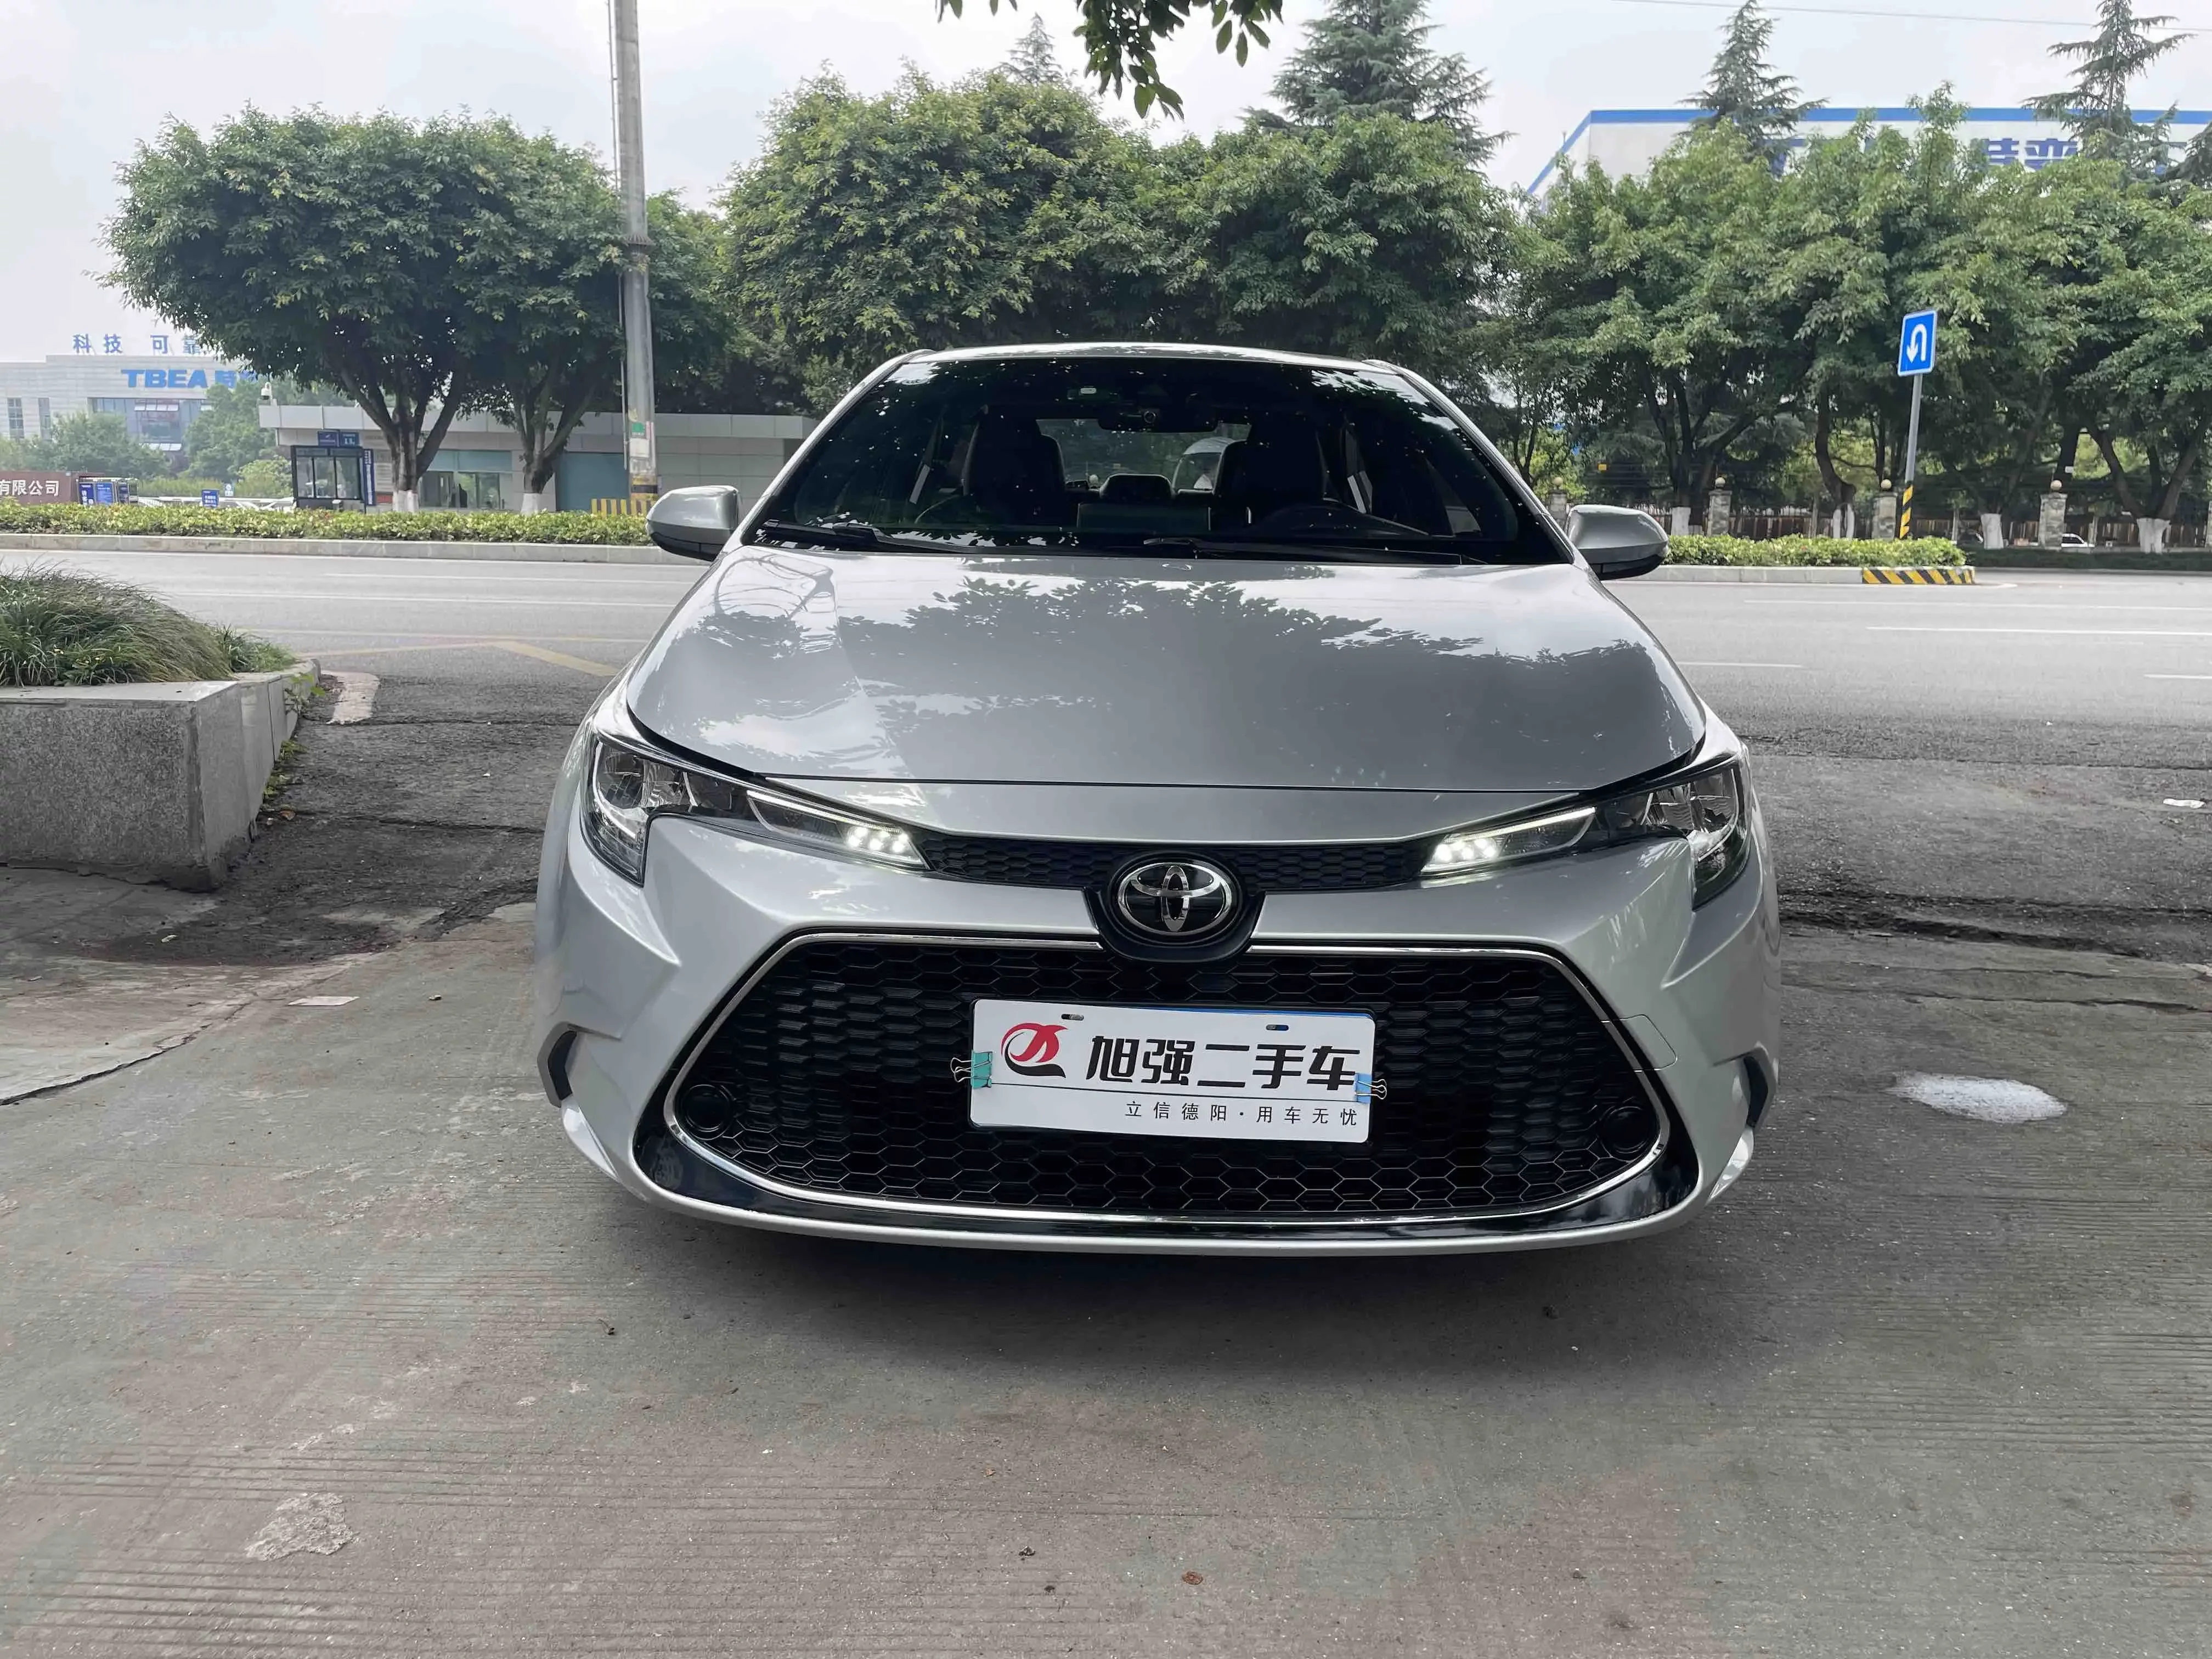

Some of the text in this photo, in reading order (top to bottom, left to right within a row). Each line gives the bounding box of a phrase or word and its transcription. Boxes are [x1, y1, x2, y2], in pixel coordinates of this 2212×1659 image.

[121, 369, 208, 388] TBEA
[0, 479, 59, 496] 有限公司
[1086, 1035, 1360, 1091] 旭强二手车
[1125, 1101, 1357, 1126] 立信德阳·用车无忧
